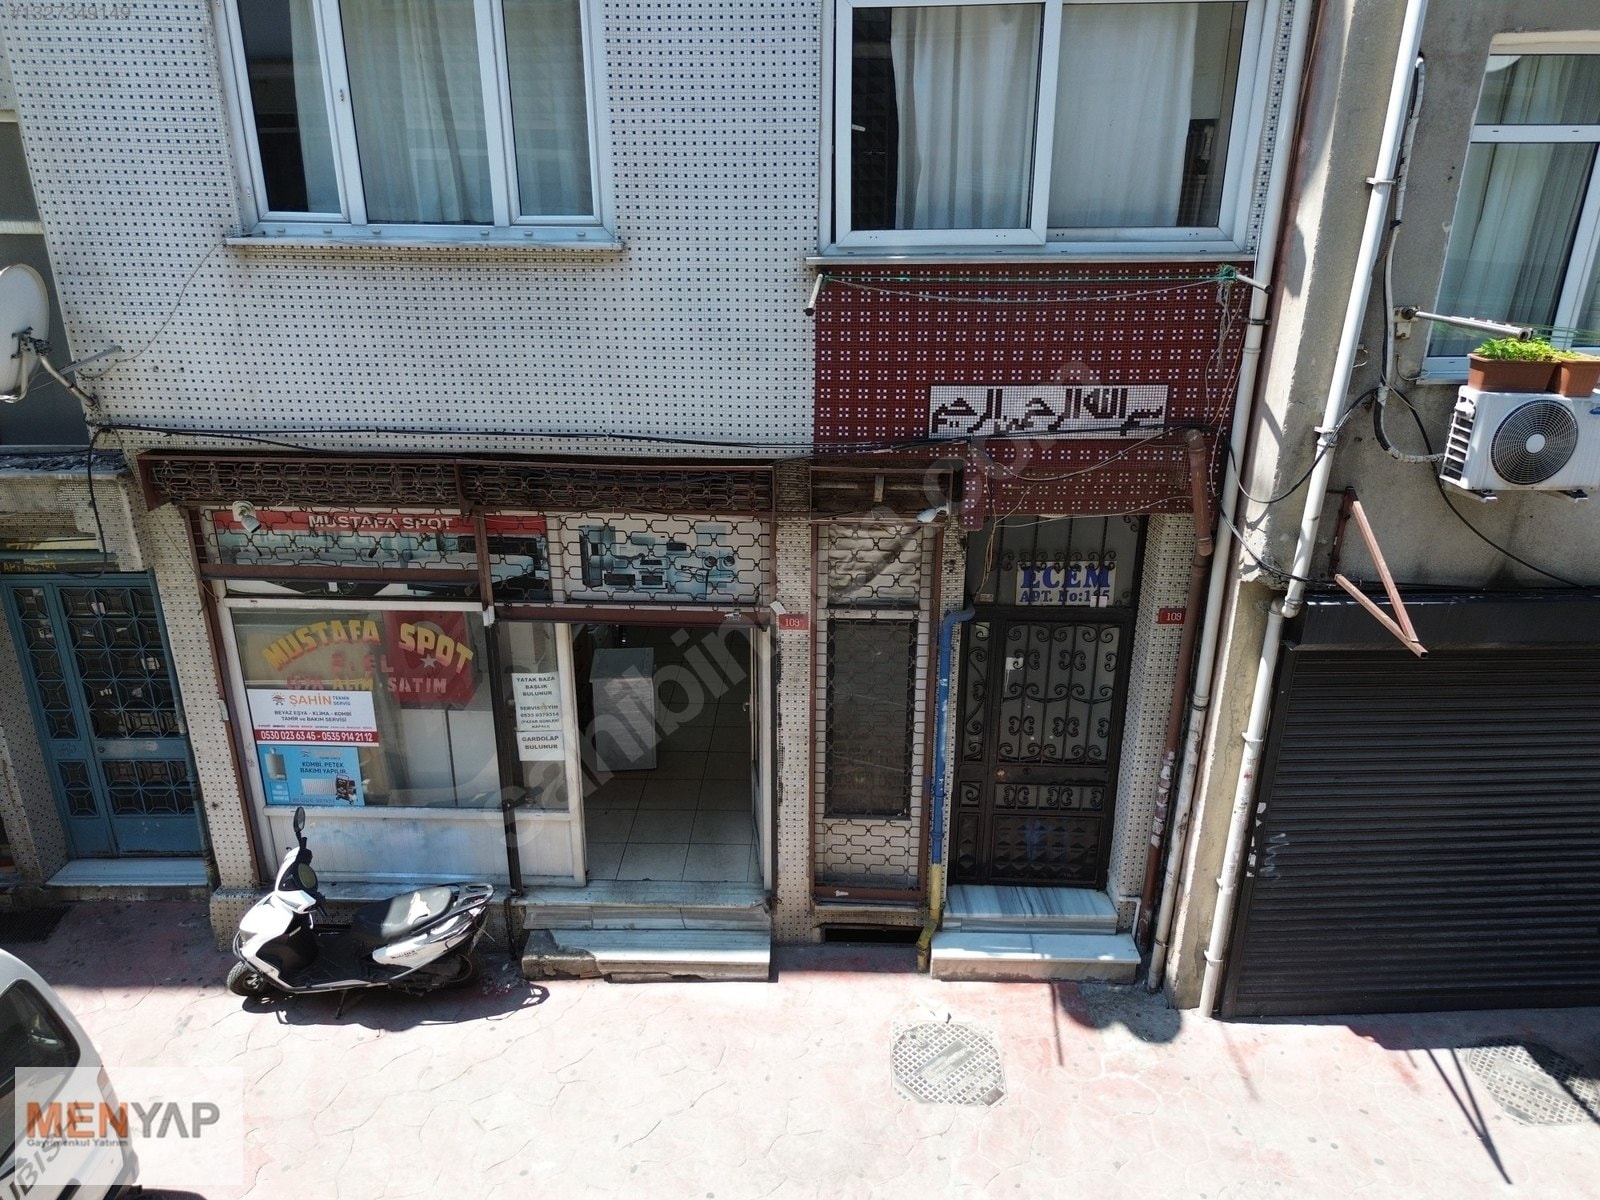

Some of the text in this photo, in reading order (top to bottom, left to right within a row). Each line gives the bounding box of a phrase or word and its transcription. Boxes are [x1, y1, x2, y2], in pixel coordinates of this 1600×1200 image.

[308, 514, 453, 530] MUSTAFA SPOT
[1020, 565, 1110, 589] ECEM
[785, 618, 800, 627] 109
[1167, 612, 1182, 621] 109
[263, 620, 474, 674] MUSTAFA SPOT
[388, 677, 447, 694] SATIM
[289, 693, 332, 707] ŞAHİN
[260, 731, 280, 740] 0530
[281, 731, 295, 740] 023
[296, 731, 306, 740] 63
[306, 732, 316, 740] 45
[321, 732, 341, 741] 0535
[341, 732, 355, 741] 914
[355, 733, 364, 741] 21
[364, 733, 374, 742] 12
